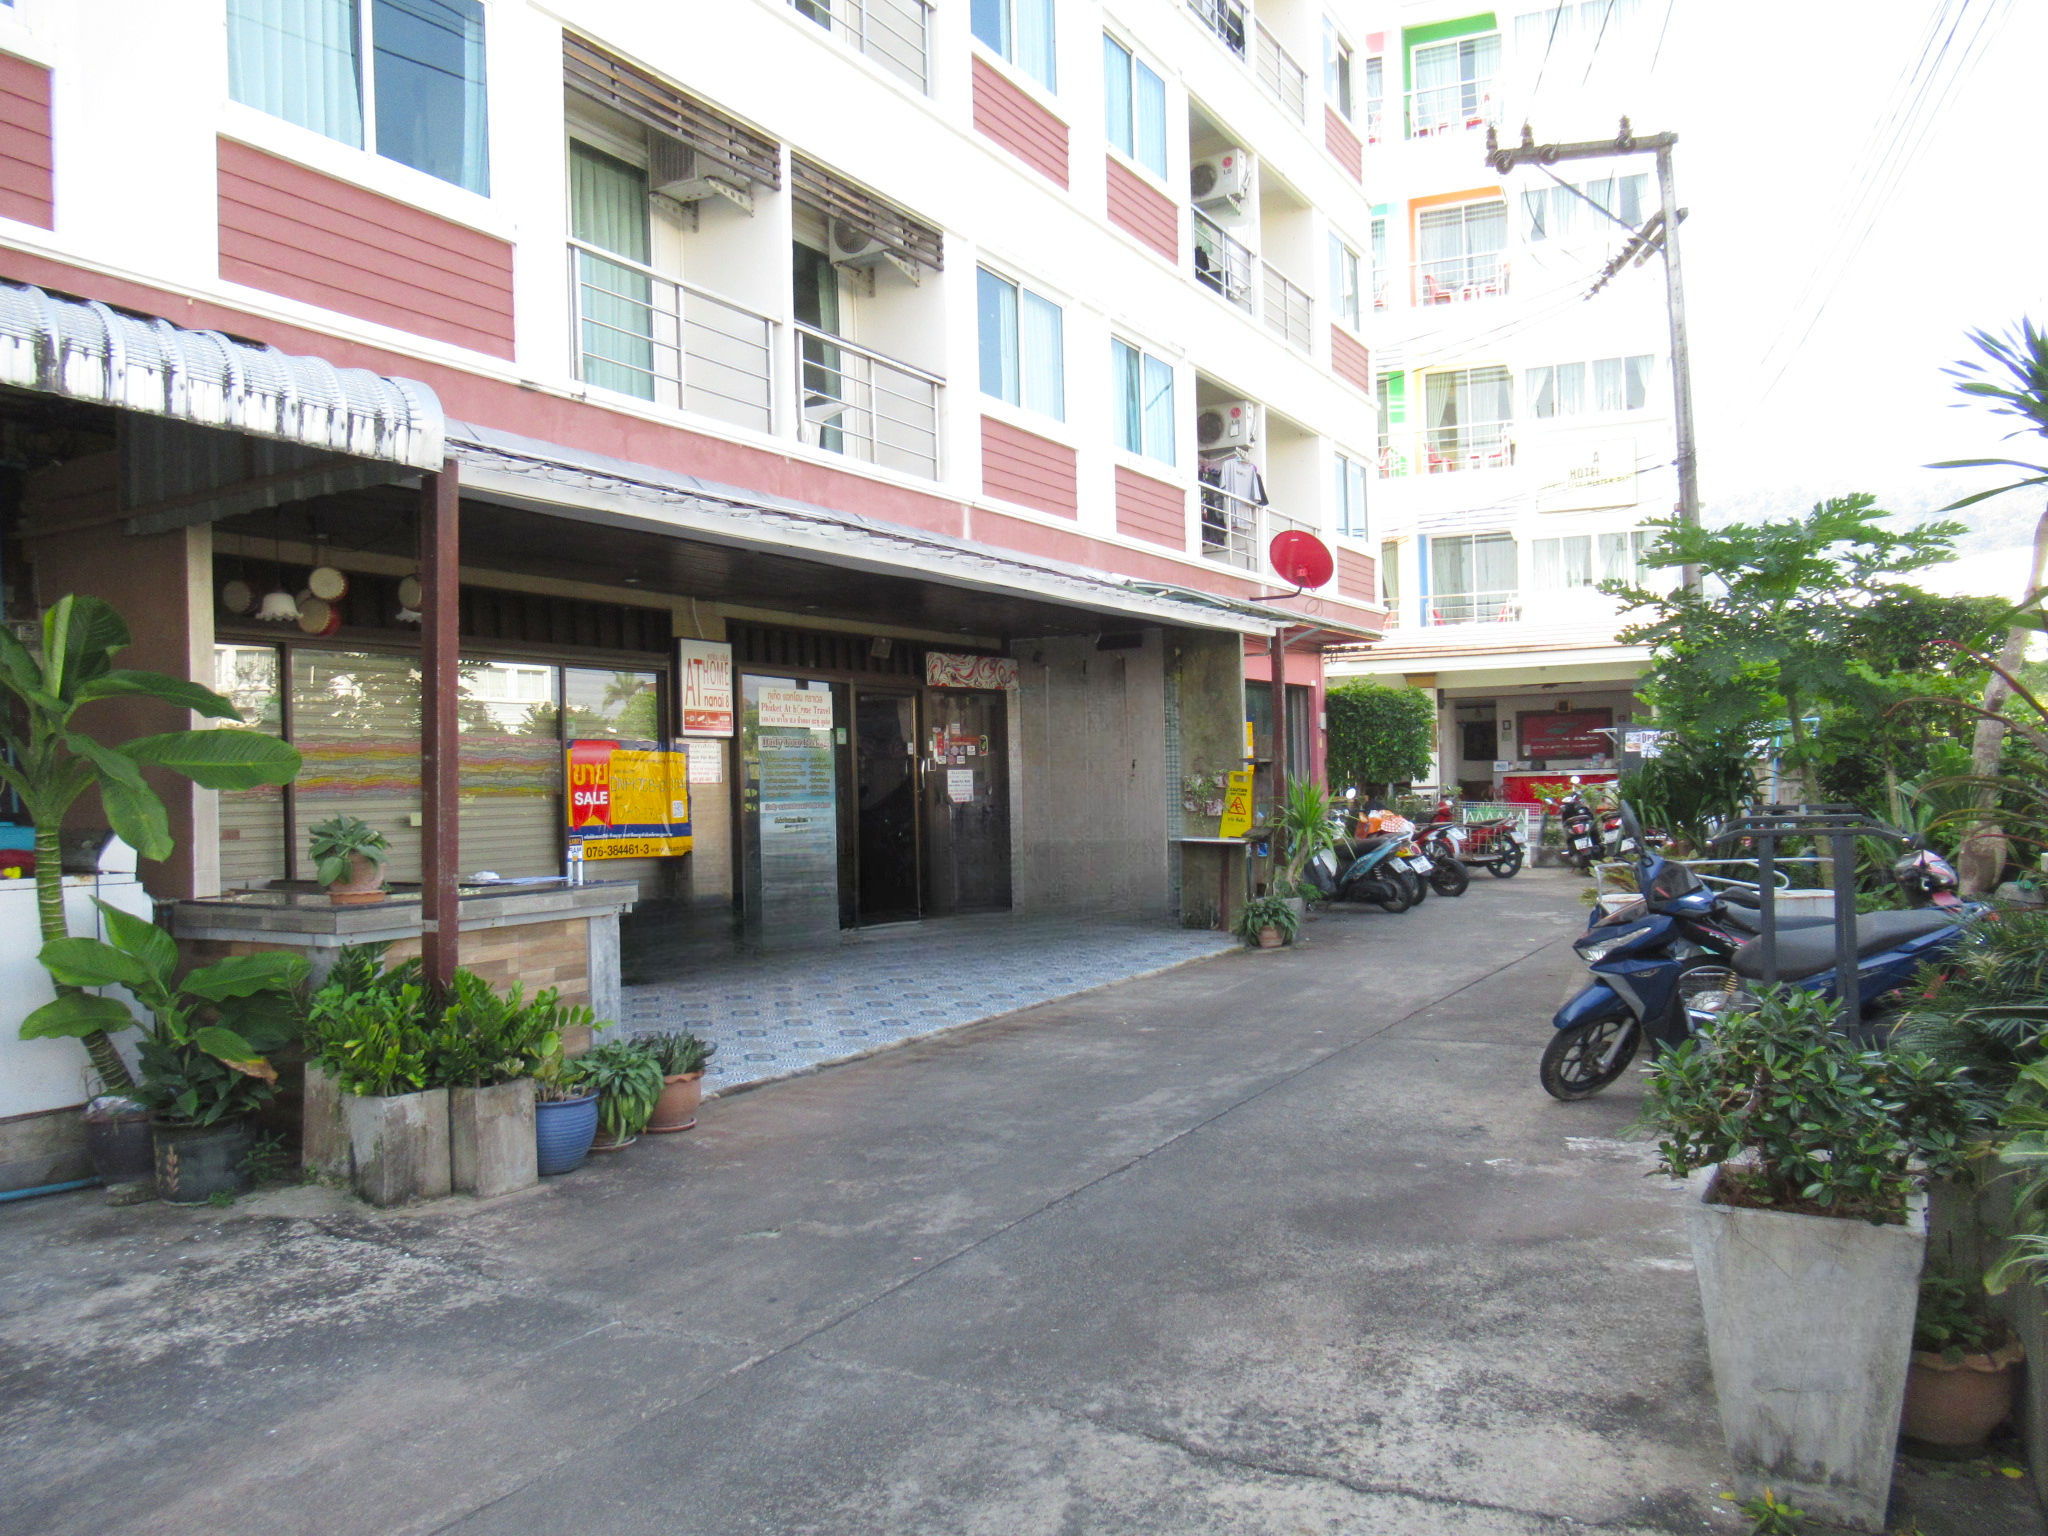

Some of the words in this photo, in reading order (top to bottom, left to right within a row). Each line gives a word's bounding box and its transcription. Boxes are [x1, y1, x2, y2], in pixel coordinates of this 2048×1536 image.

[685, 658, 703, 706] AT
[703, 661, 730, 686] HOME
[725, 694, 730, 708] 8
[761, 702, 782, 712] Phuket
[784, 703, 791, 713] At
[812, 705, 831, 715] Travel
[573, 763, 609, 786] ขาย
[574, 791, 608, 806] SALE
[586, 844, 649, 859] 076-384461-3
